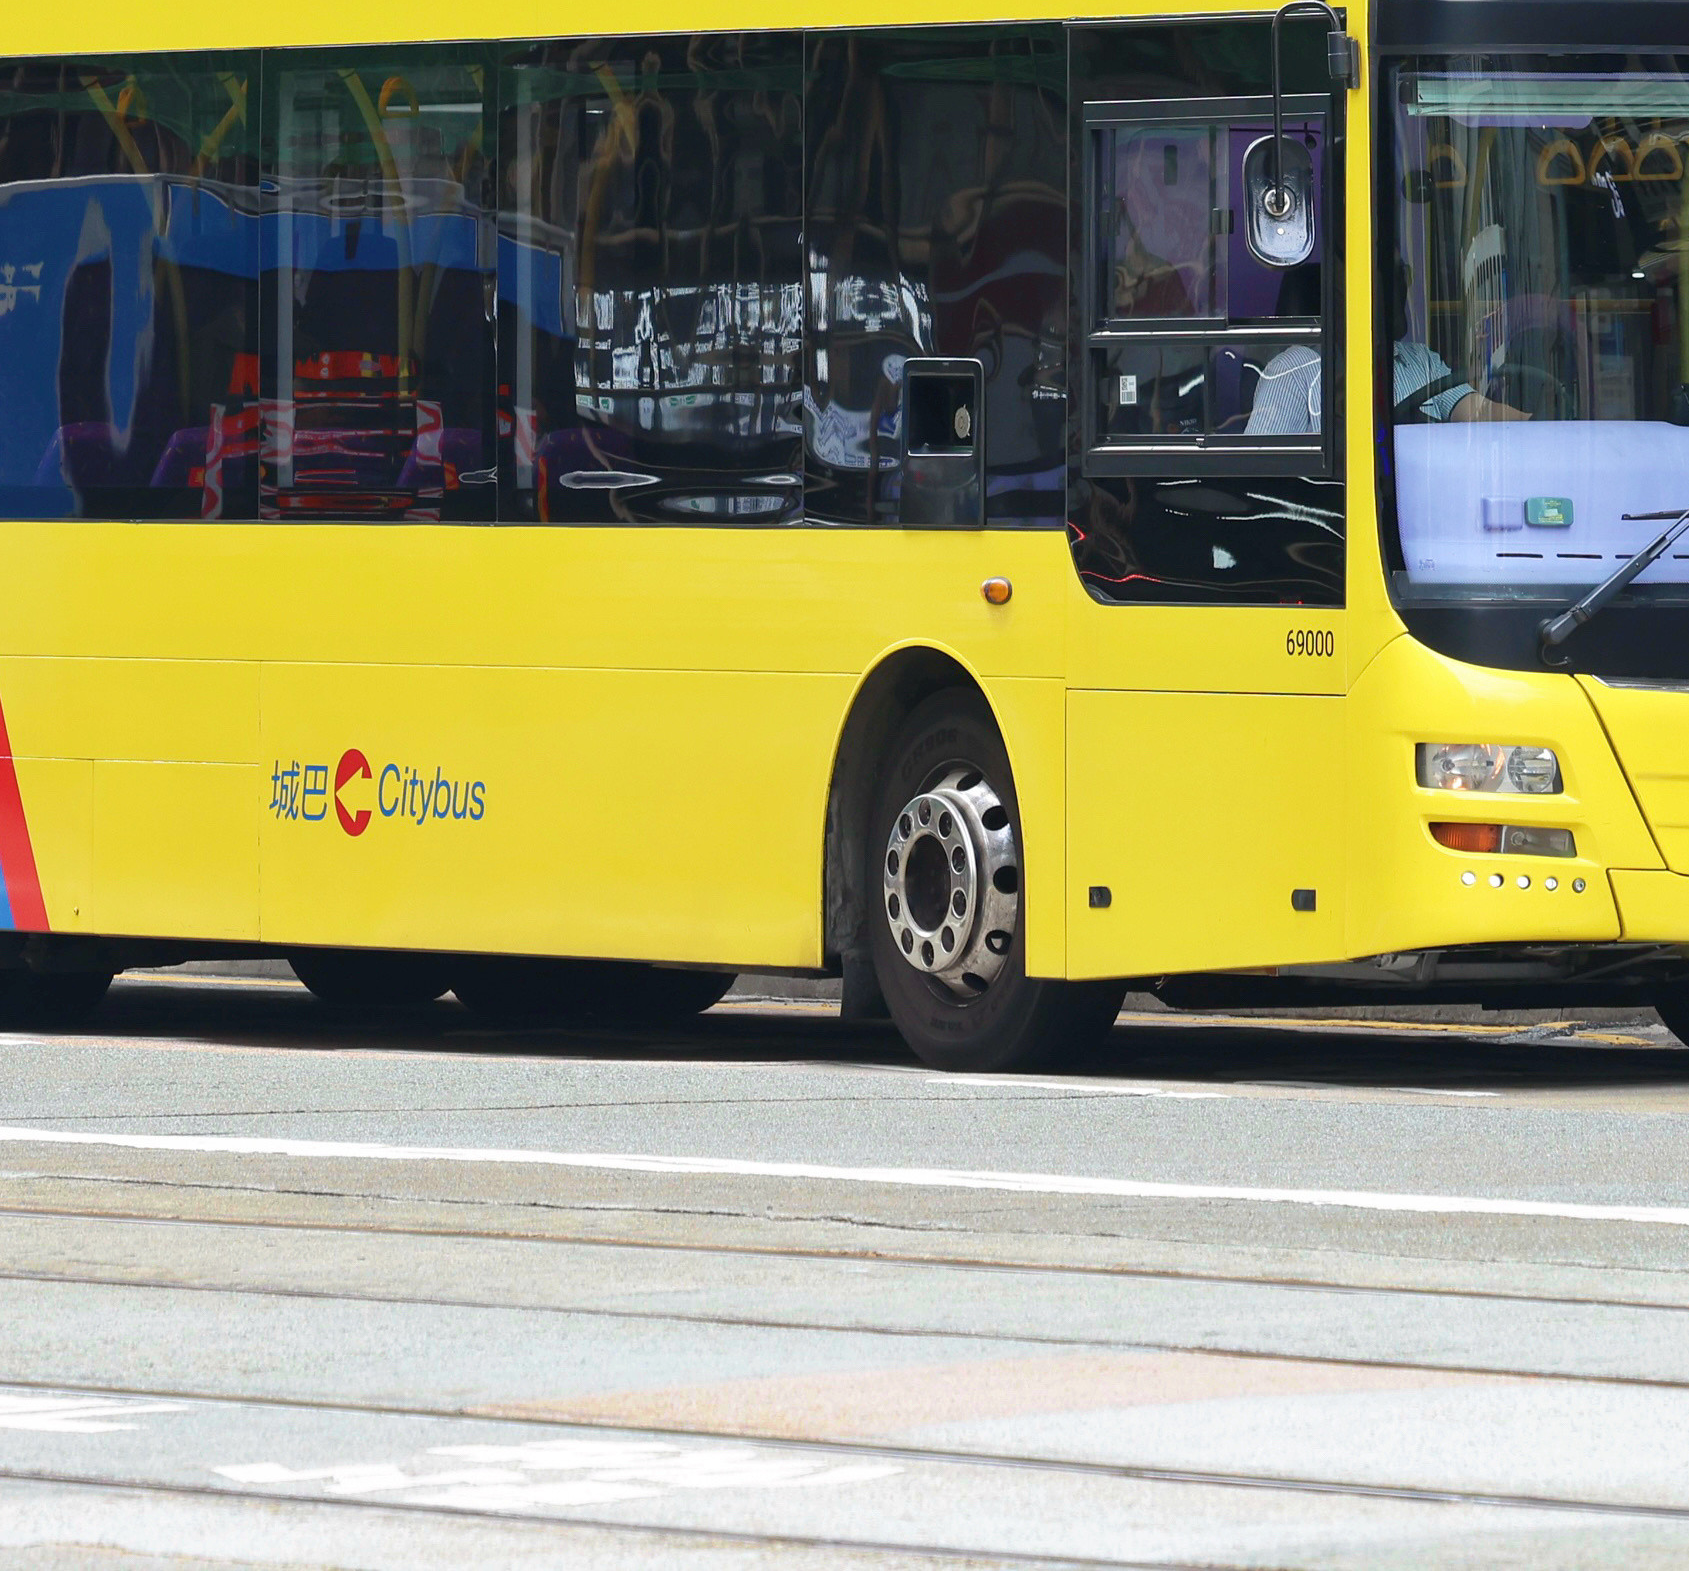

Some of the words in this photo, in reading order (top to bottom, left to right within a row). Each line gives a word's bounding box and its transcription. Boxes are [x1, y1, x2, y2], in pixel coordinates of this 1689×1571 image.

[1285, 628, 1335, 659] 69000
[269, 760, 328, 821] 城巴
[378, 762, 486, 826] Citybus
